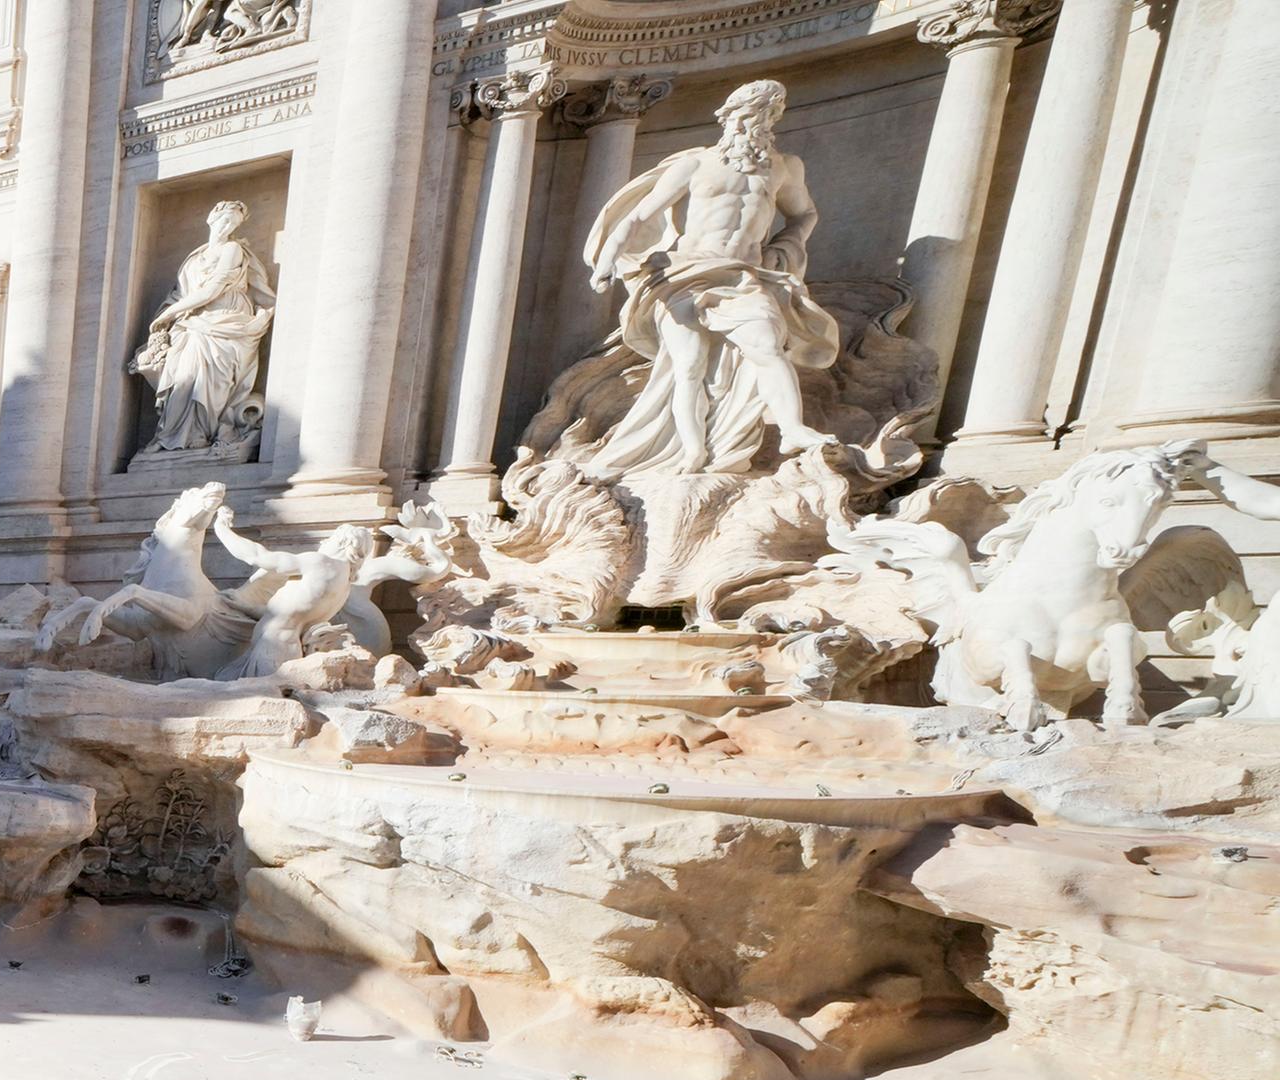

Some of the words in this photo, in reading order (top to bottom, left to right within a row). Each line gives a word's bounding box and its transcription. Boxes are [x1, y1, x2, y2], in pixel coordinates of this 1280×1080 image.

[566, 50, 608, 66] IVSSV
[617, 29, 764, 66] CLEMENTIS
[124, 132, 177, 158] POSITIS
[183, 120, 232, 144] SIGNIS
[243, 112, 263, 129] ET
[272, 100, 313, 122] ANA
